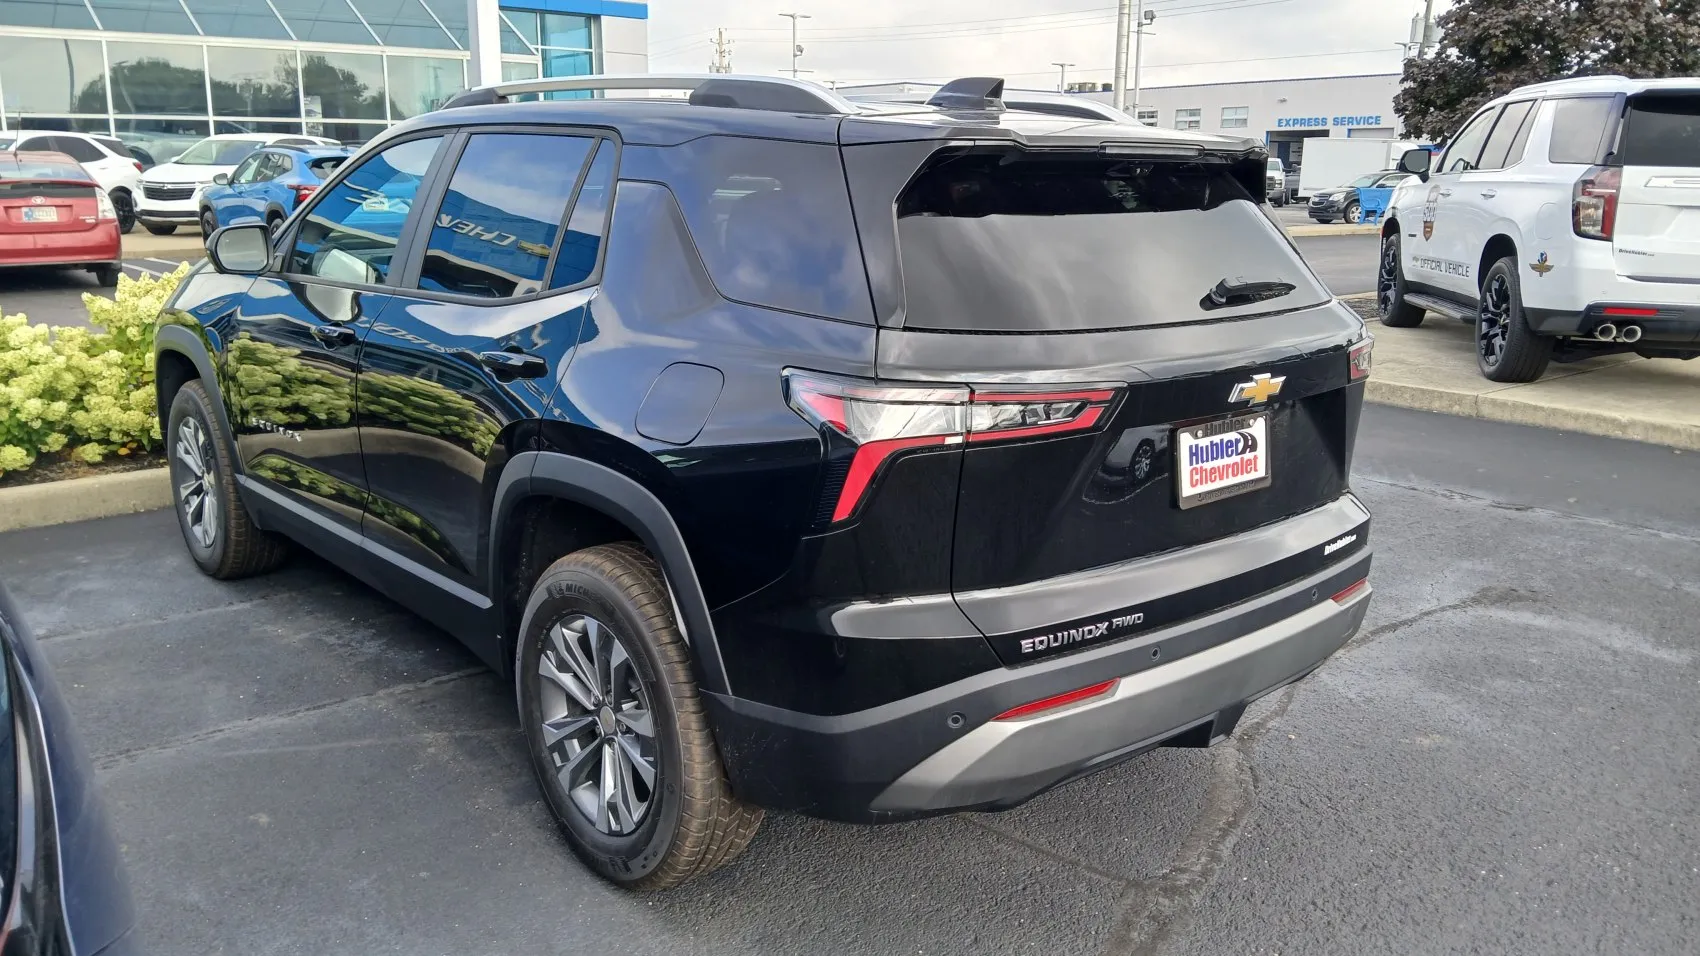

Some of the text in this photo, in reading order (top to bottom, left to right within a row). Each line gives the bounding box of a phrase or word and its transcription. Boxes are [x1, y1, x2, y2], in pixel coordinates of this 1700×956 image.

[1277, 115, 1382, 128] EXPRESS SERVICE
[1420, 258, 1470, 278] OFFICIAL VEHICLE
[1204, 417, 1246, 436] Hubler
[1188, 437, 1241, 466] Hubler
[1189, 455, 1258, 488] Chevrolet
[1020, 612, 1144, 653] EQUINOX AWD
